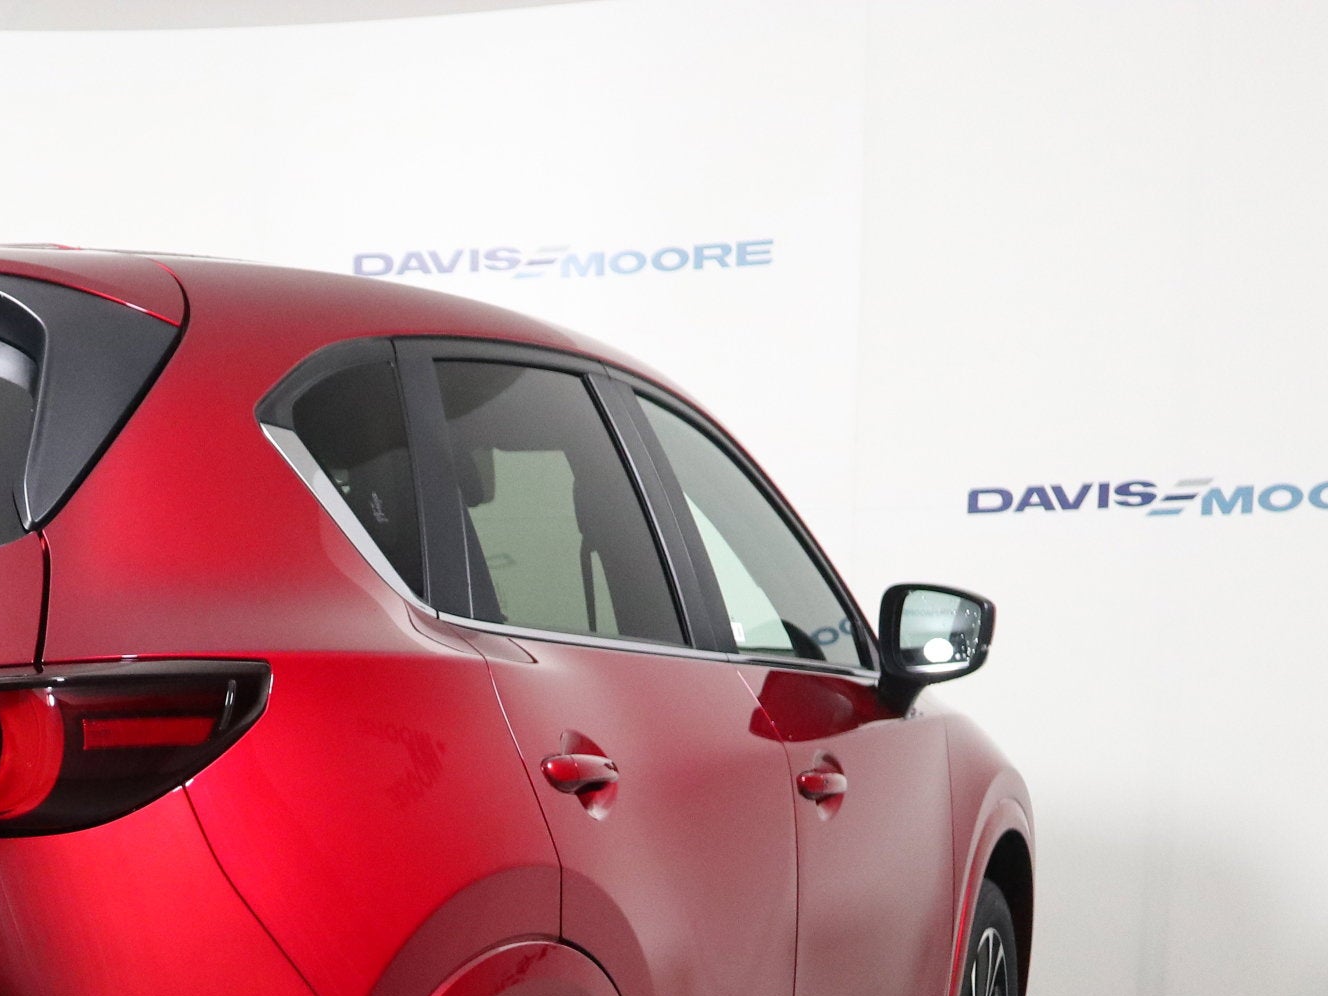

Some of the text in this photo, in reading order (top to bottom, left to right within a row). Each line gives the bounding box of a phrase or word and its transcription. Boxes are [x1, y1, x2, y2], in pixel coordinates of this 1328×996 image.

[352, 239, 774, 279] DAVIS MOORE
[967, 480, 1158, 515] DAVIS
